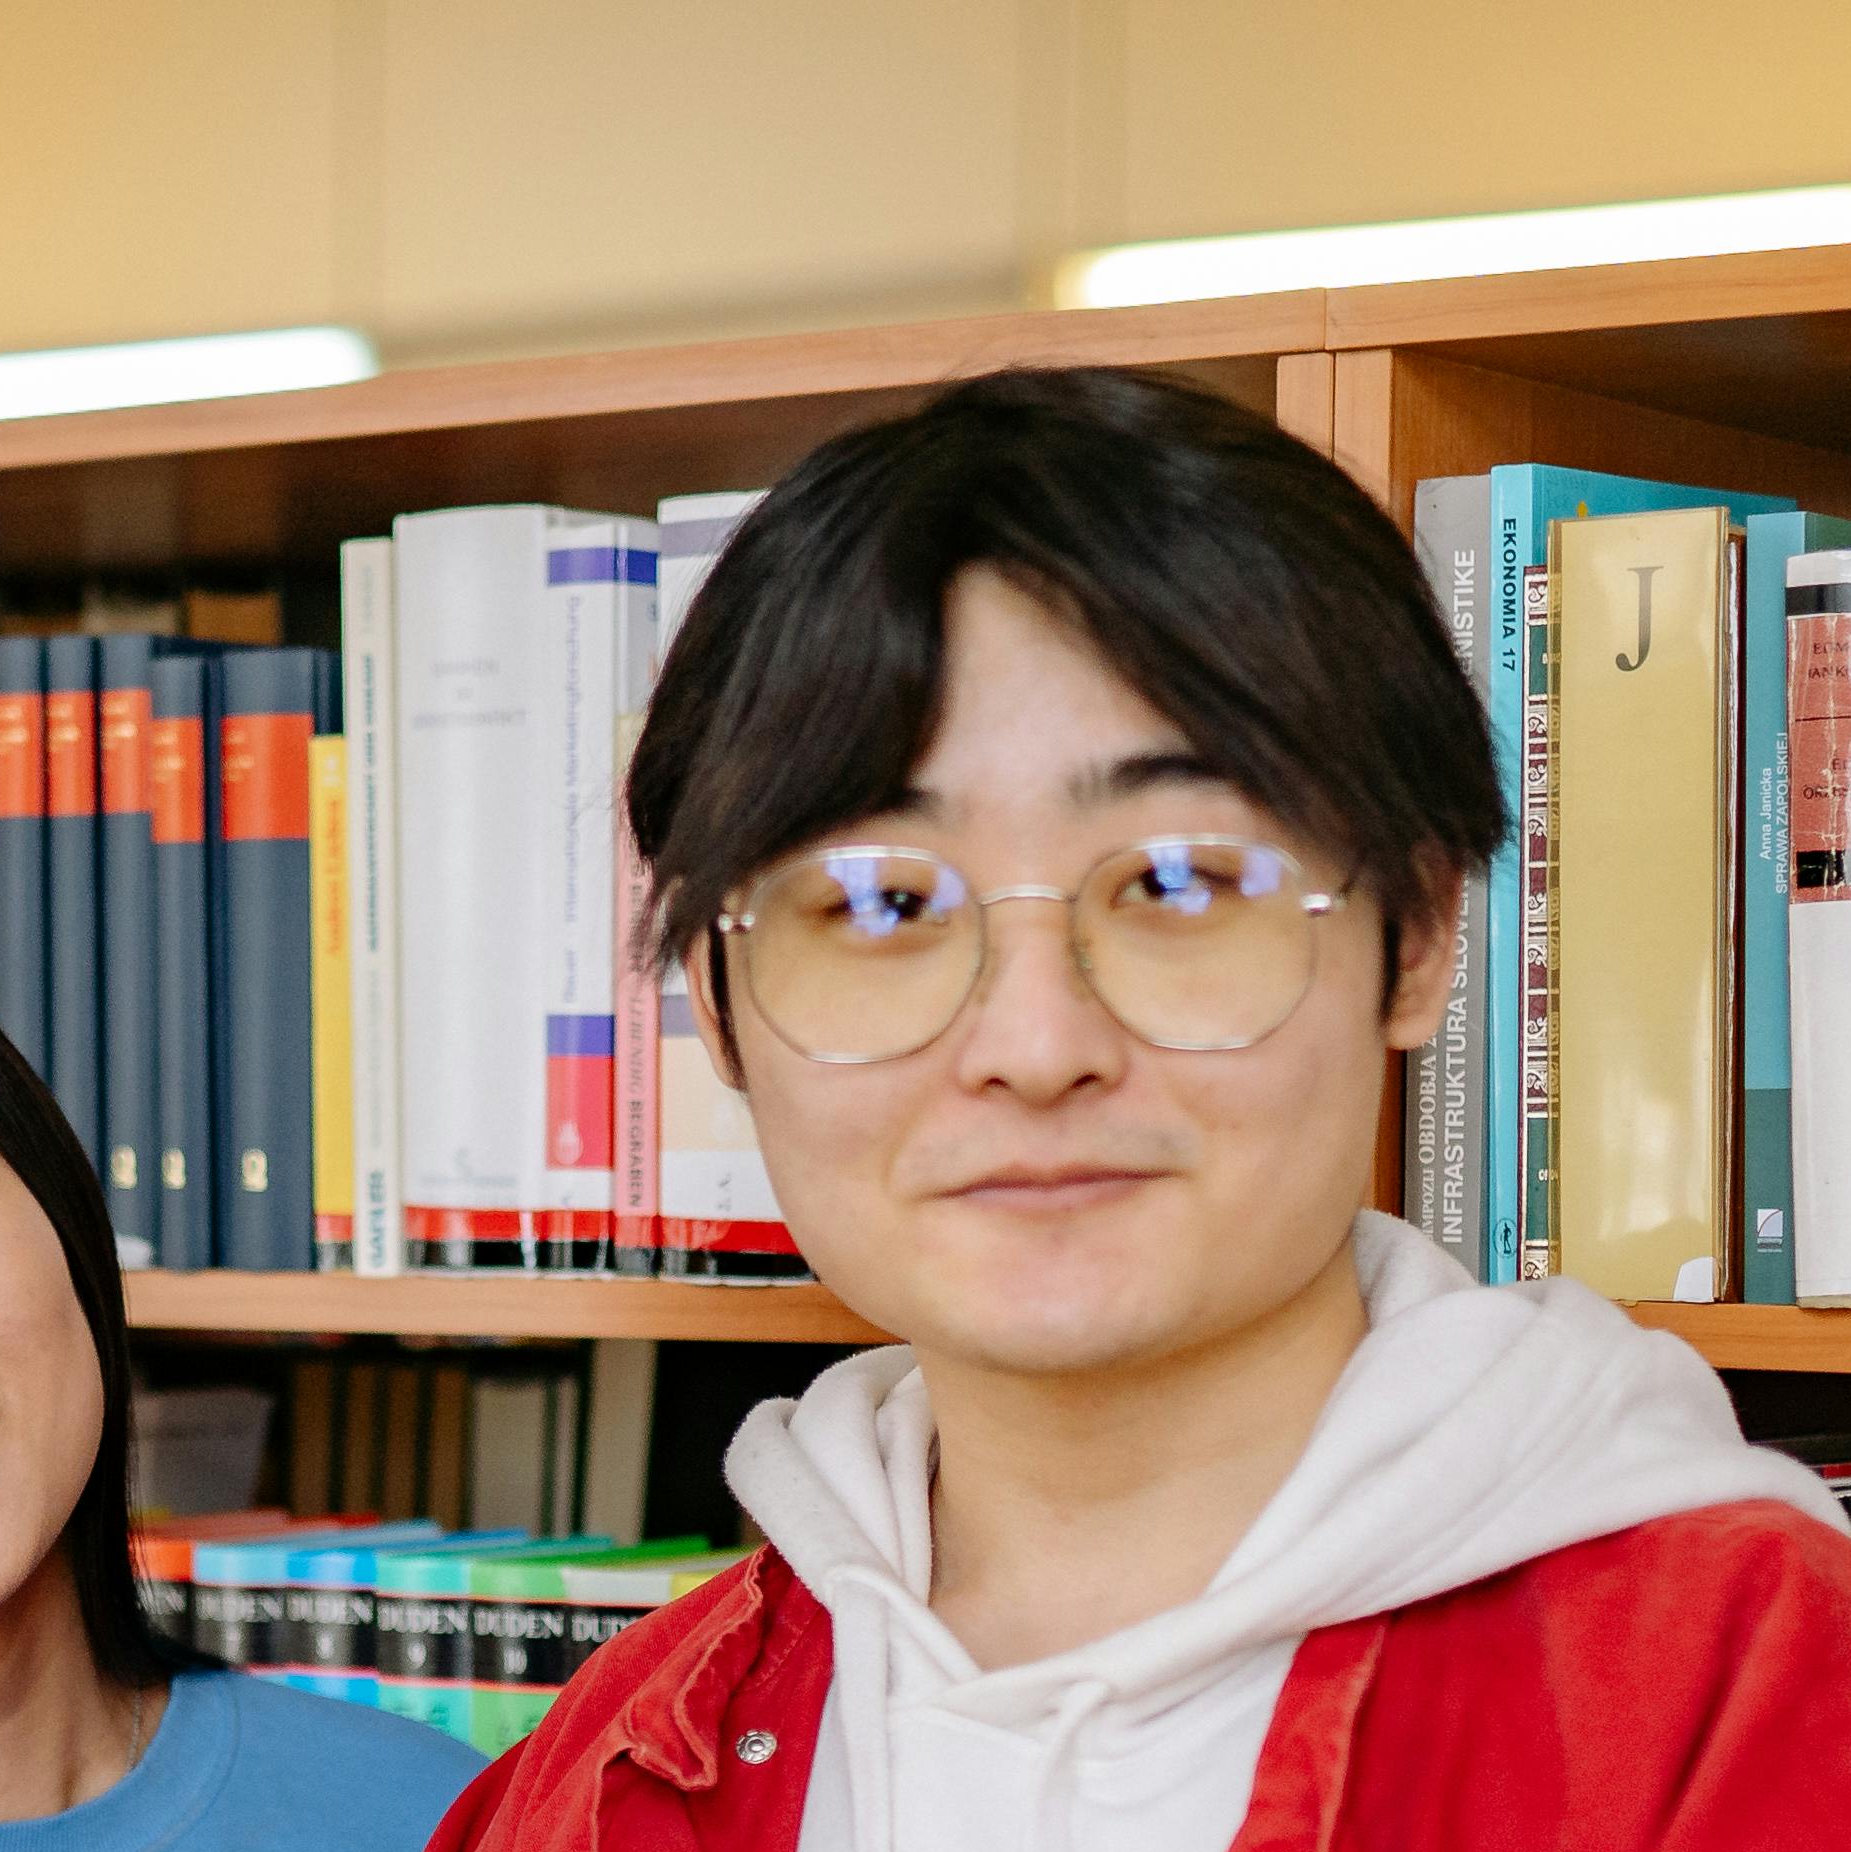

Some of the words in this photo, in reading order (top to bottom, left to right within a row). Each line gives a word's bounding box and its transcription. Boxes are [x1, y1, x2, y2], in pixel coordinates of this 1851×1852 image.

[1503, 518, 1516, 638] EKONOMIA
[1615, 564, 1665, 672] J
[1503, 648, 1516, 672] 17
[1759, 768, 1773, 820] Janicka
[1776, 733, 1788, 825] ZAPOLSKIEJ
[1759, 823, 1773, 860] Anna
[1776, 829, 1788, 894] SPRAWA
[1418, 1056, 1438, 1164] OBDOBJA
[1443, 998, 1468, 1243] INFRASTRUKTURA
[377, 1604, 468, 1635] DUDEN
[474, 1608, 565, 1640] DUDEN
